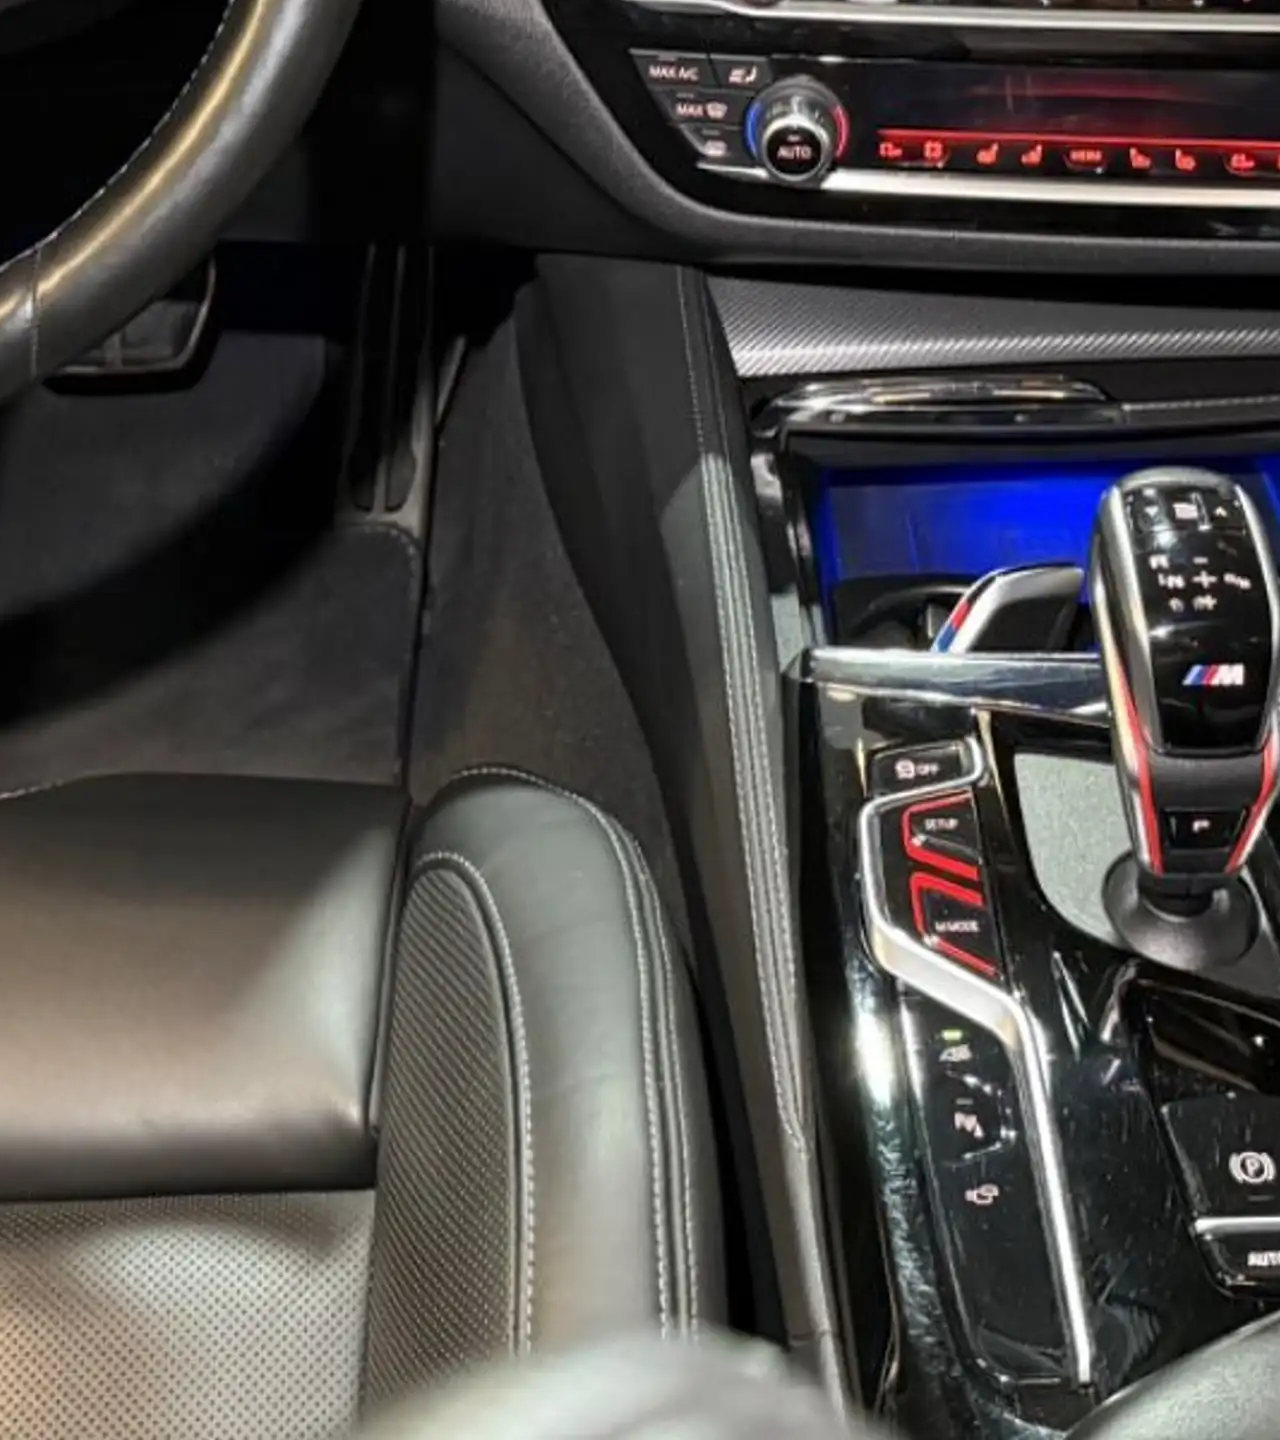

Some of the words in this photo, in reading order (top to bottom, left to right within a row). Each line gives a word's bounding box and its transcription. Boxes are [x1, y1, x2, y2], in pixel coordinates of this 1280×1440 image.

[648, 64, 676, 79] MAX
[675, 102, 704, 118] MAX
[777, 145, 813, 160] AUTO
[925, 817, 959, 831] SETUP
